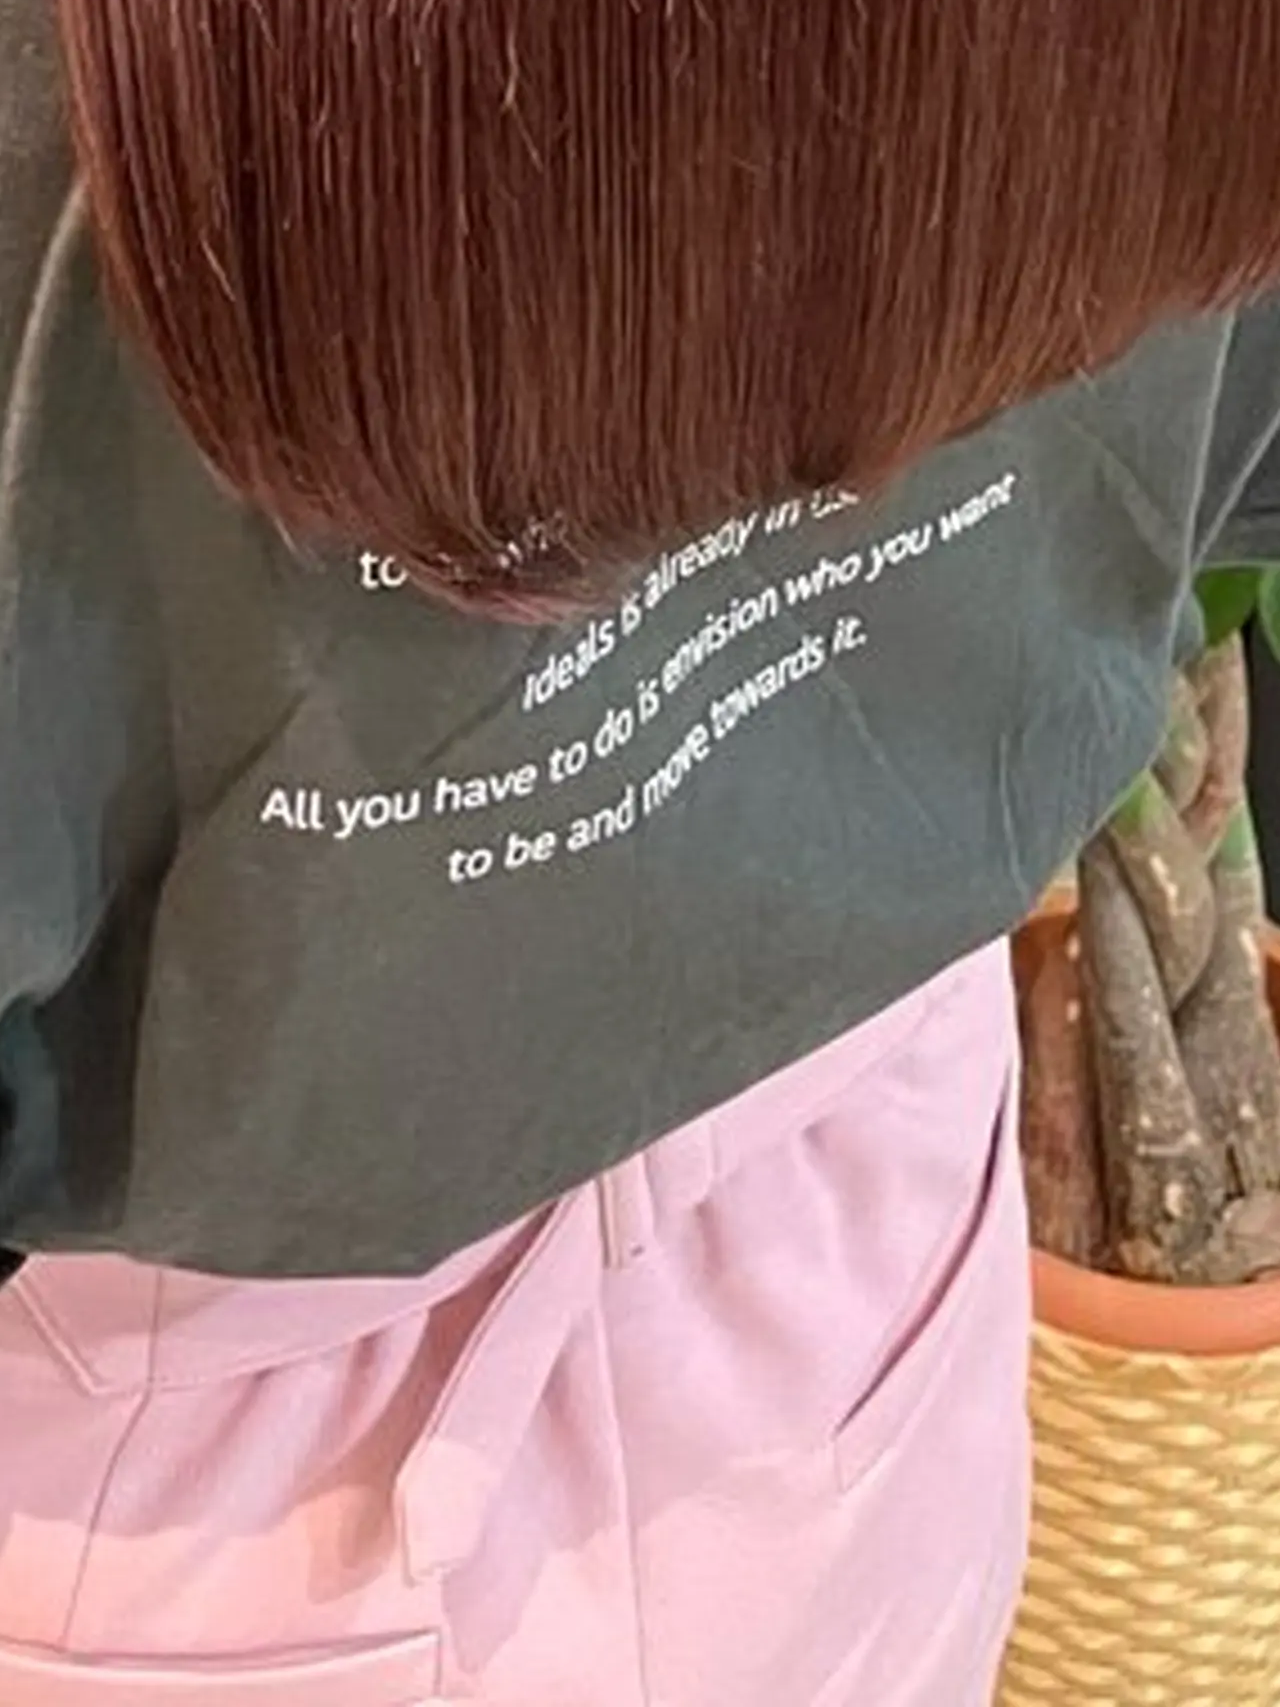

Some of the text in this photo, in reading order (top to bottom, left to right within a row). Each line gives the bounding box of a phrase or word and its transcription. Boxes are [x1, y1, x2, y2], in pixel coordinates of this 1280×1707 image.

[260, 472, 1017, 840] All you have to do is envision who you want
[522, 618, 616, 711] Ideals
[621, 591, 642, 636] is
[643, 512, 757, 609] already
[448, 848, 494, 884] to
[504, 831, 557, 869] be
[566, 784, 635, 852] and
[710, 634, 827, 740] towards
[832, 616, 868, 654] it.
